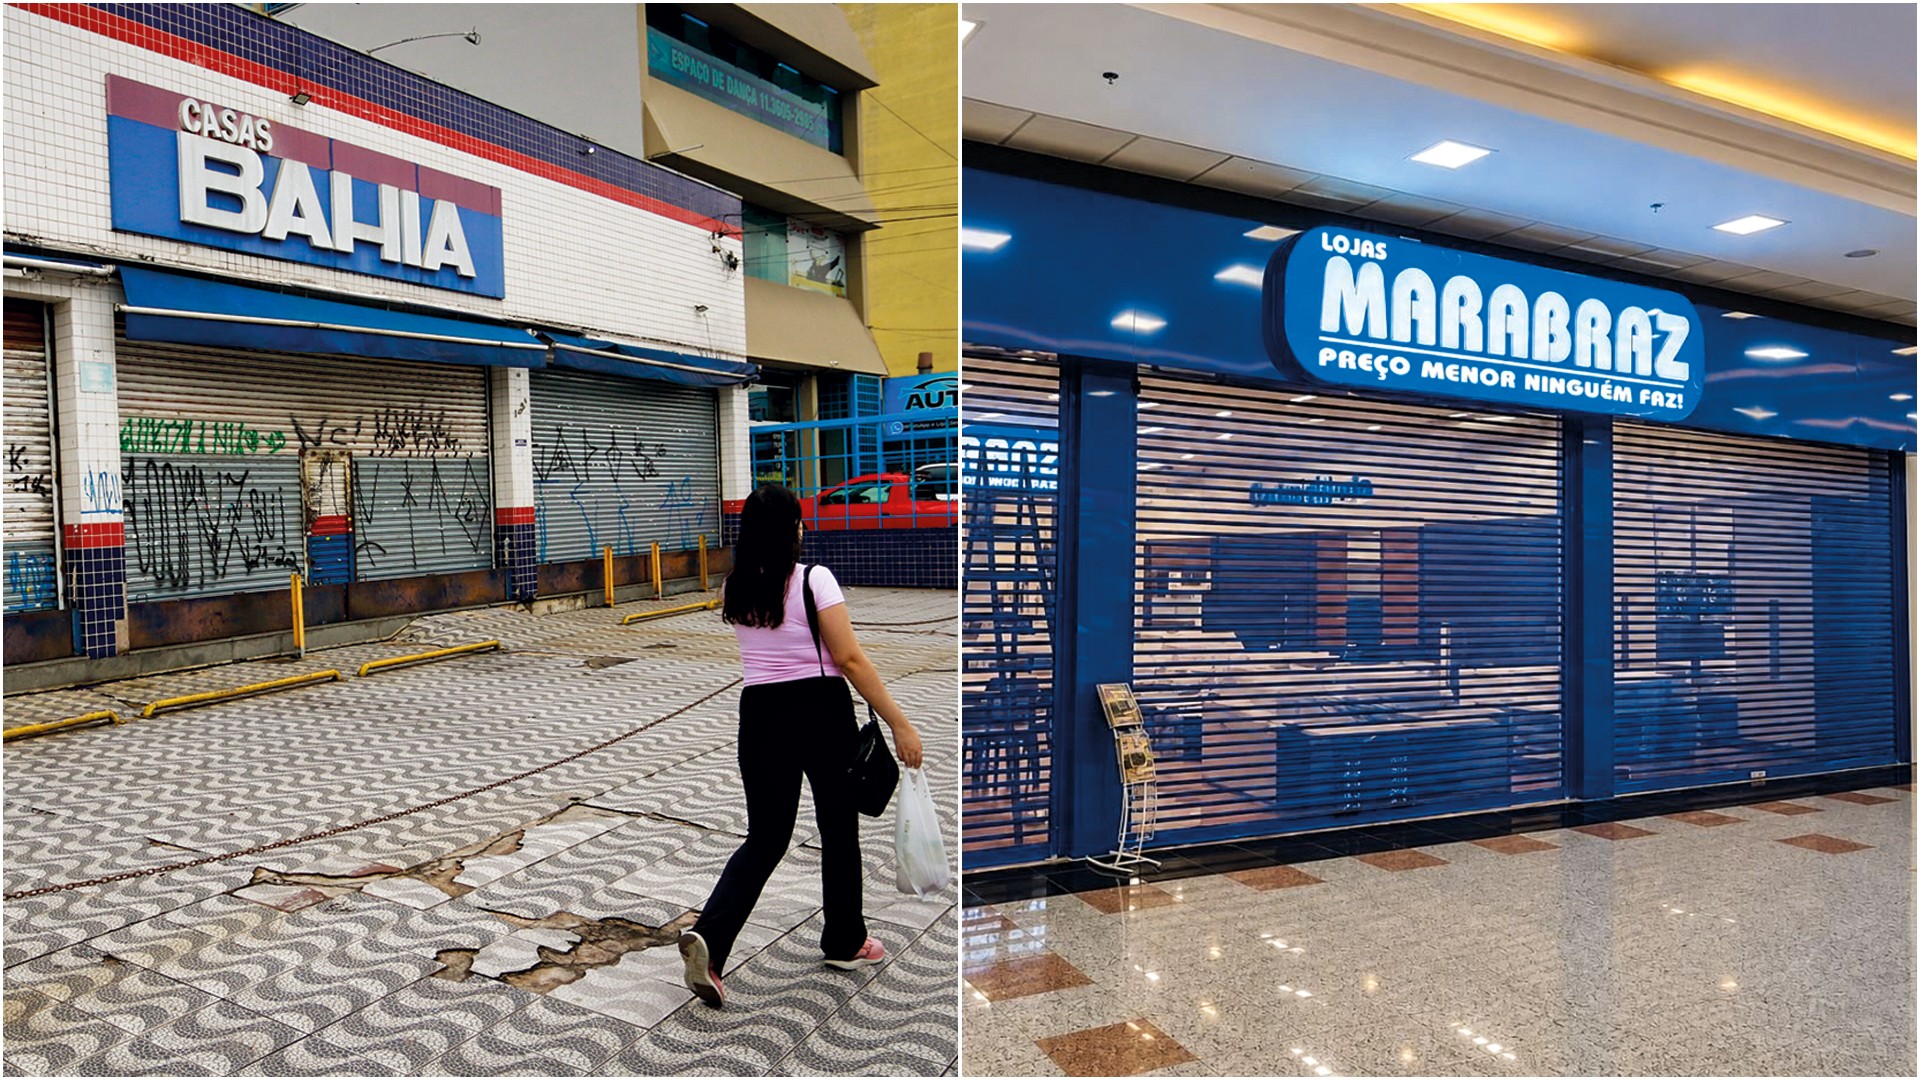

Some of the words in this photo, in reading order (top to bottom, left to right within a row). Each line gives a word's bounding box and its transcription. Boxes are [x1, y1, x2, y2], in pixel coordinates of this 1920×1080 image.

[671, 49, 709, 84] ESPAÇO
[712, 68, 724, 90] DE
[726, 75, 757, 106] DANÇA
[178, 98, 273, 152] CASAS
[177, 131, 476, 278] BAHIA
[1321, 232, 1387, 260] LOJAS
[1320, 255, 1690, 381] MARABRAZ
[1318, 347, 1410, 380] PREÇO
[1421, 361, 1515, 388] MENOR
[1524, 374, 1632, 403] NINGUÉM
[1639, 390, 1684, 409] FAZ!
